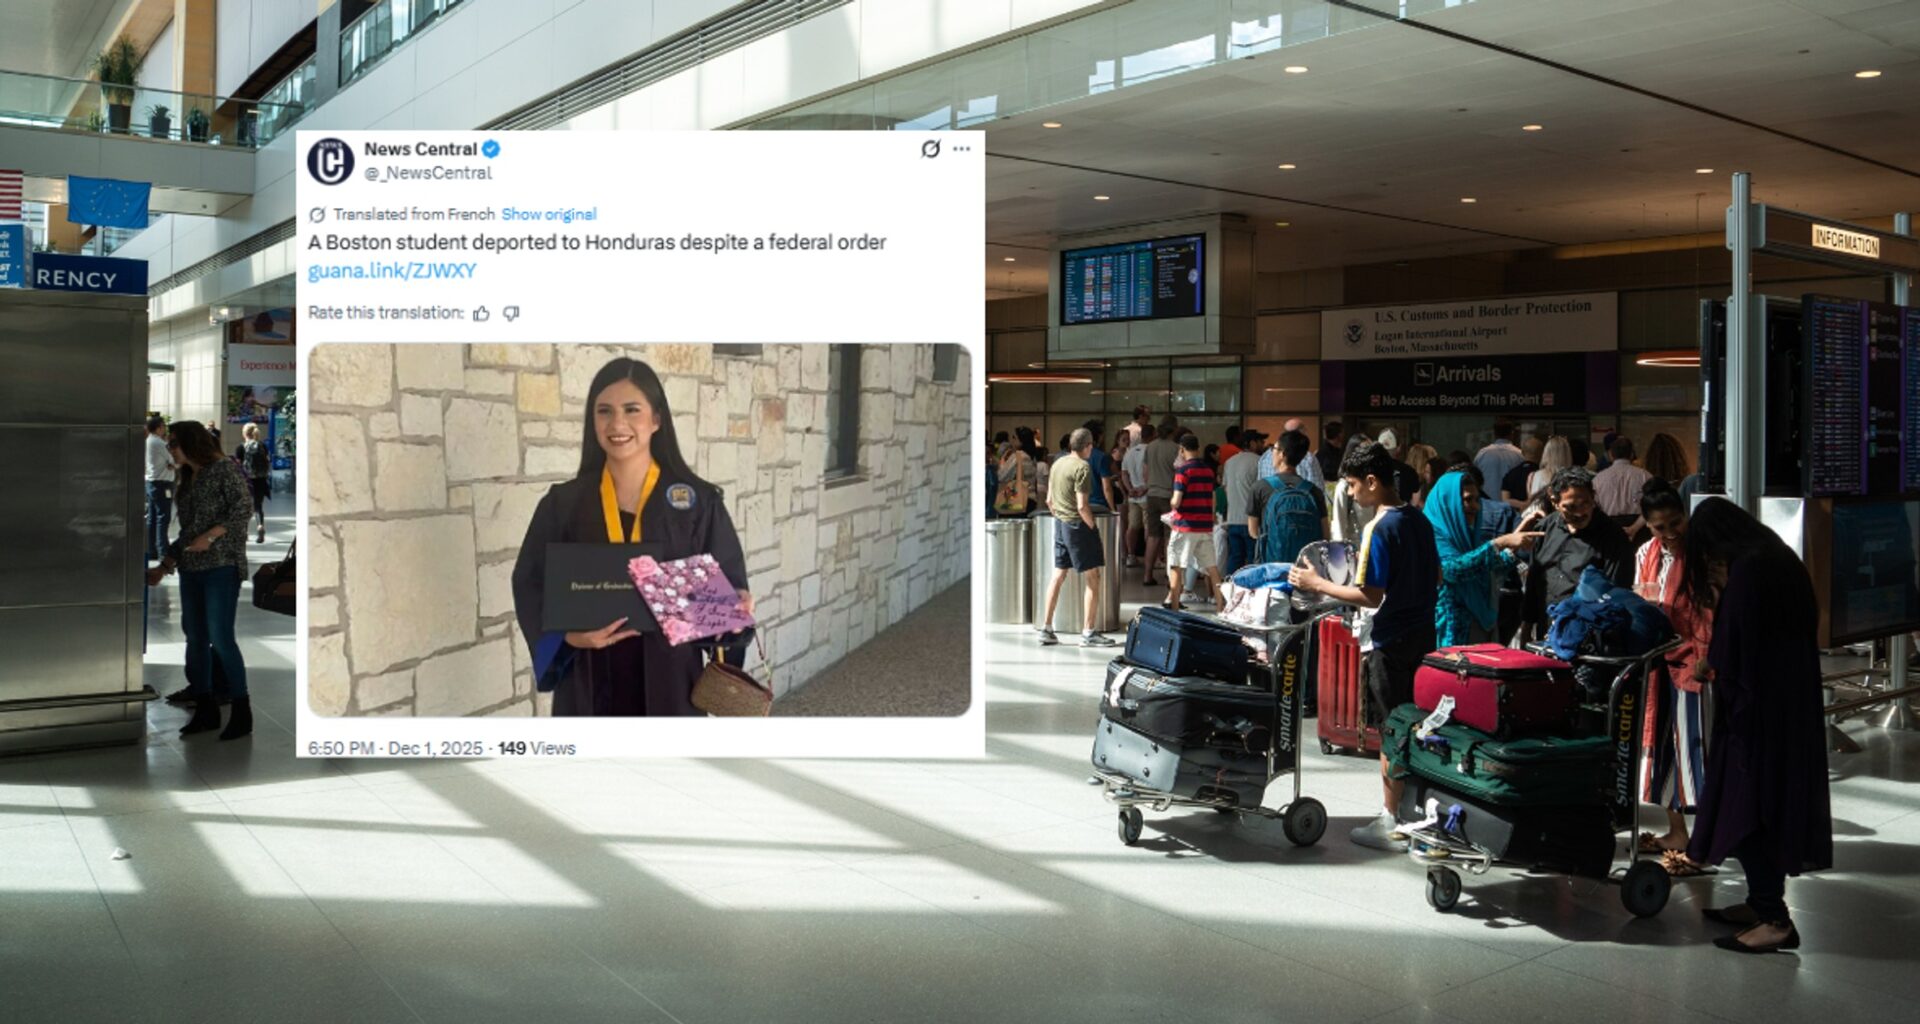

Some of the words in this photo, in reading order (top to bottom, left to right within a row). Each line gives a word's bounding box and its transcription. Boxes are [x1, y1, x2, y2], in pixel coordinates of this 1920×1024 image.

[1815, 229, 1878, 256] INFORMATION
[37, 268, 117, 289] RENCY
[1374, 309, 1397, 323] U.S.
[1401, 308, 1449, 322] Customs
[1452, 305, 1473, 319] and
[1478, 303, 1521, 318] Border
[1525, 299, 1593, 315] Protection
[1374, 331, 1403, 343] Logan
[1406, 327, 1467, 341] International
[1470, 325, 1508, 342] Airport
[1411, 341, 1479, 353] Massachusetts
[1436, 363, 1502, 382] Arrivals
[1381, 395, 1397, 408] No
[1399, 394, 1437, 407] Access
[1439, 394, 1480, 409] Beyond
[1482, 393, 1506, 407] This
[1510, 392, 1540, 406] Point
